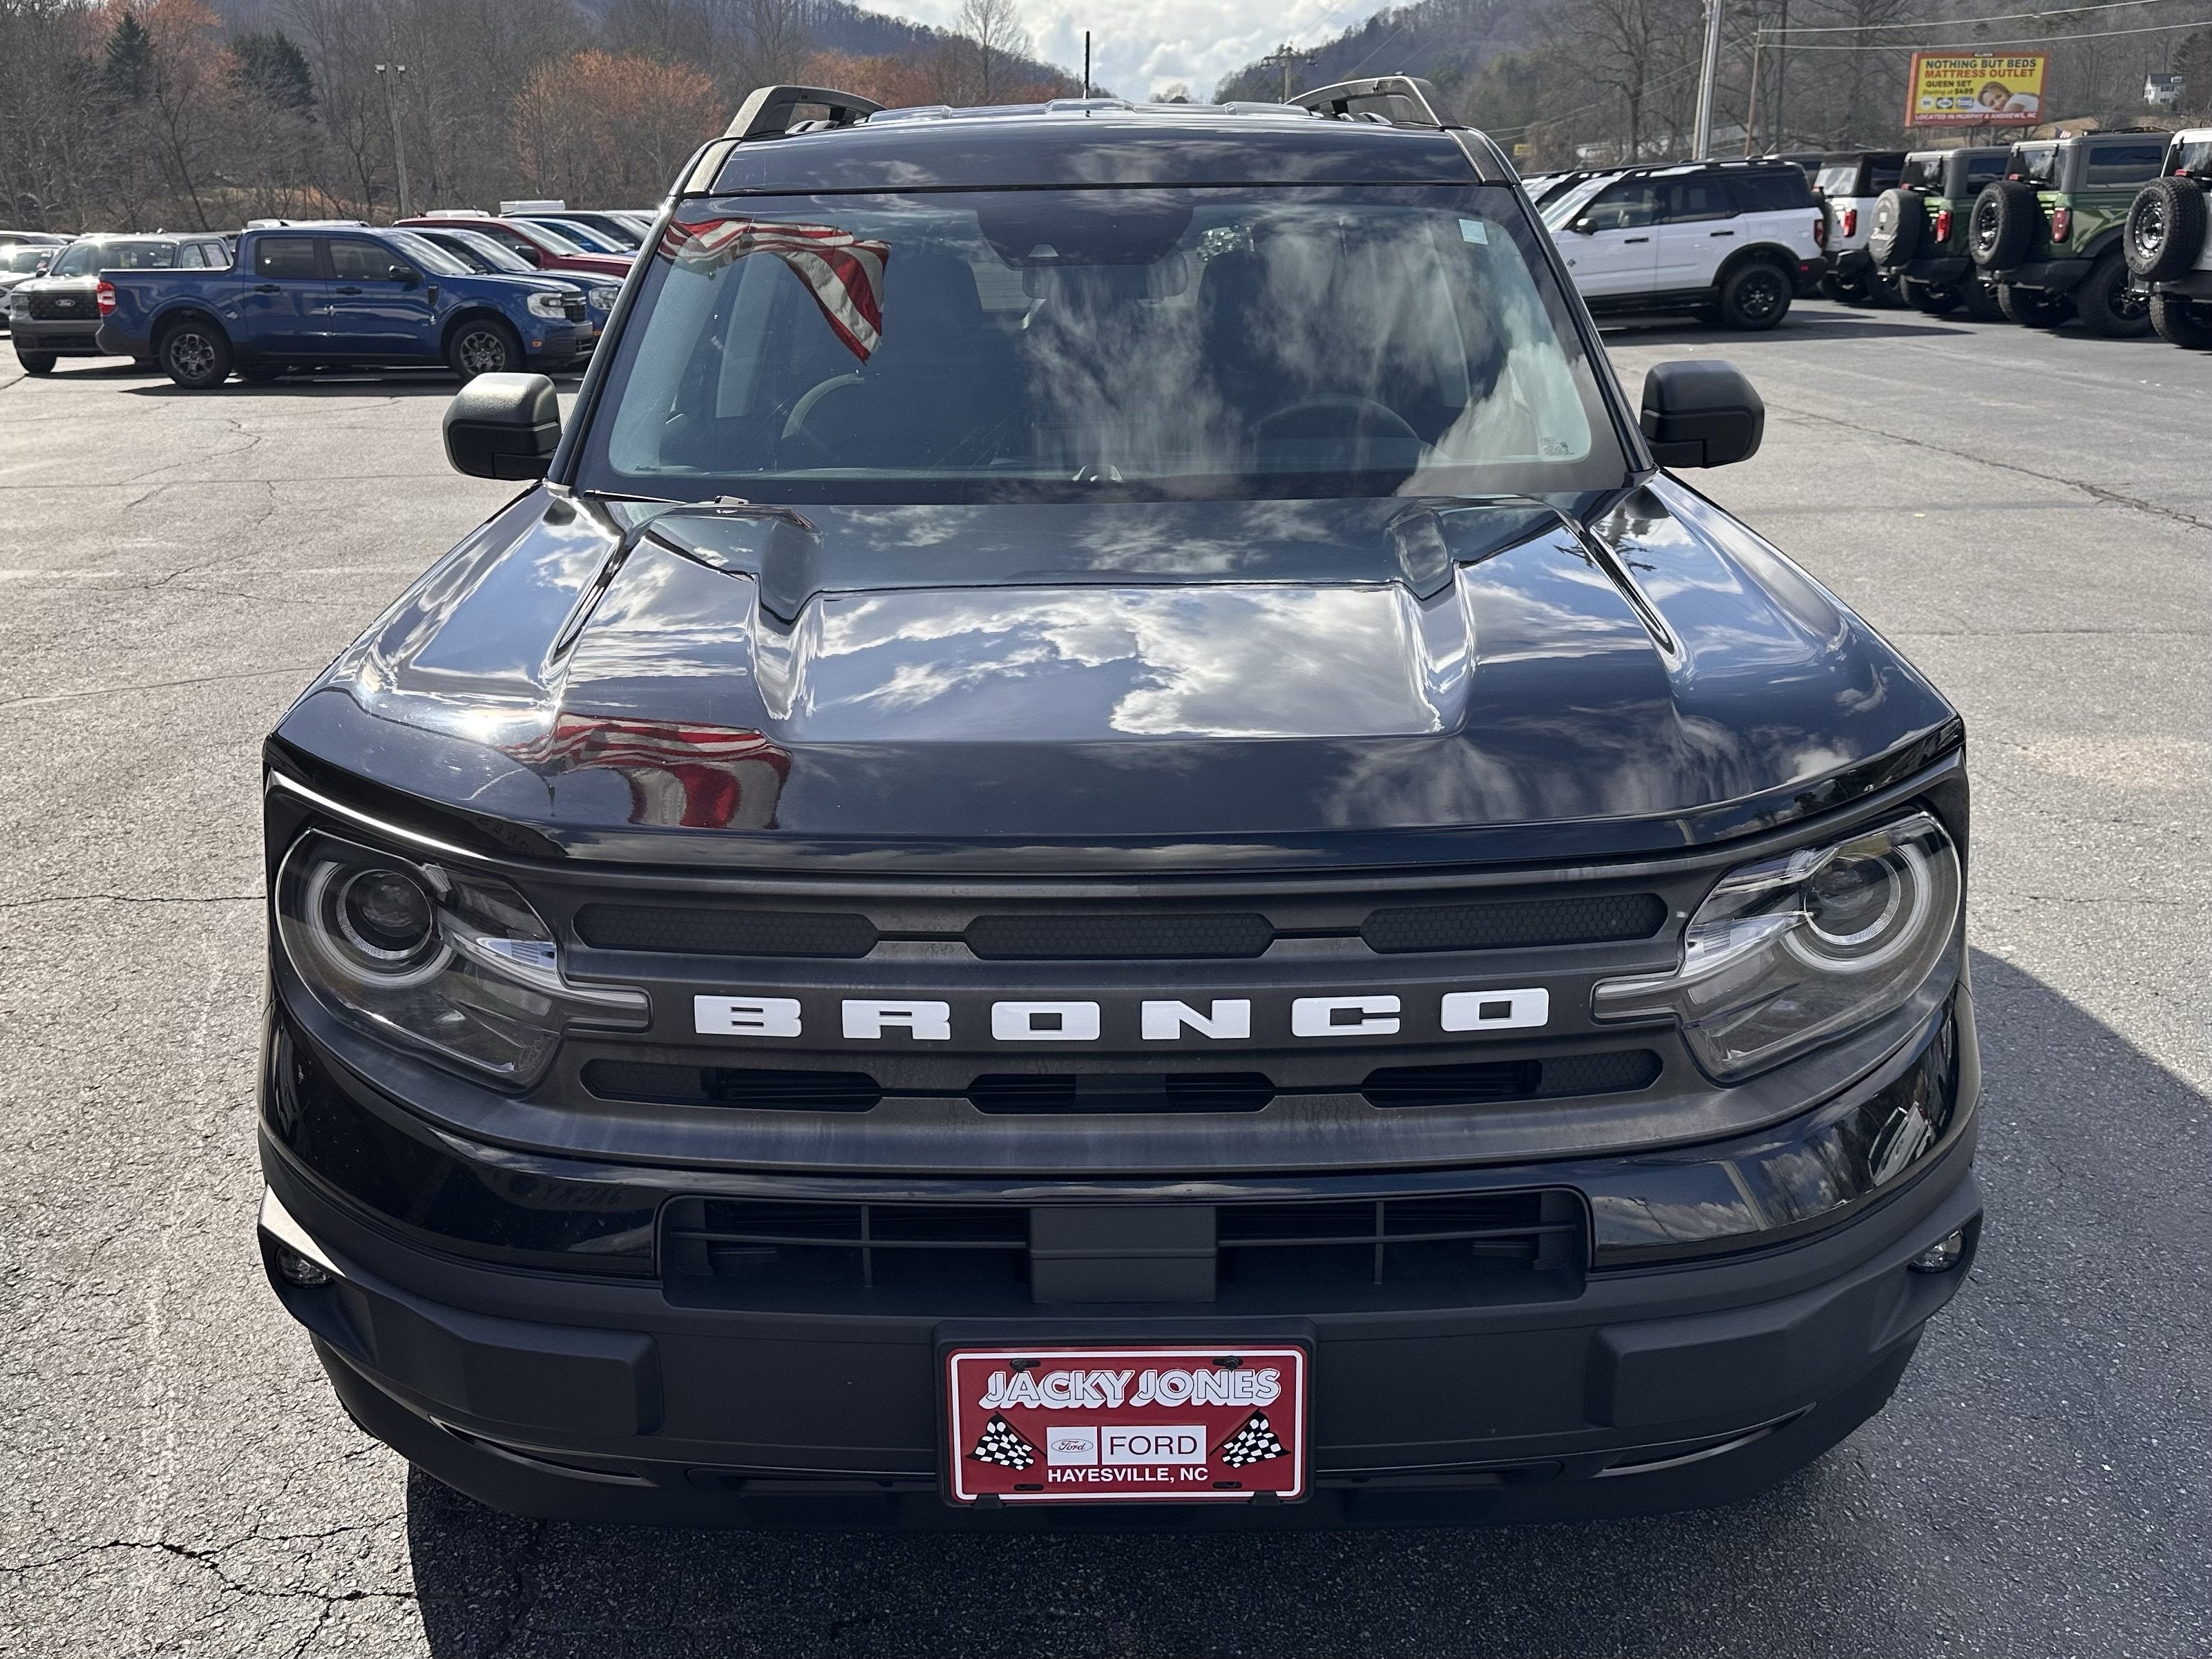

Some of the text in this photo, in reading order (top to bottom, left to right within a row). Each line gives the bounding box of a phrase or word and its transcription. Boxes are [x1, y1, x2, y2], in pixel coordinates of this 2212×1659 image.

[1926, 59, 2037, 68] NOTHING BUT BEDS
[1925, 69, 2035, 78] MATTRESS OUTLET
[694, 988, 1550, 1042] BRONCO
[979, 1368, 1281, 1409] JACKY JONES
[1058, 1436, 1197, 1455] Ford FORD
[1048, 1468, 1208, 1483] HAYESVILLE, NC
